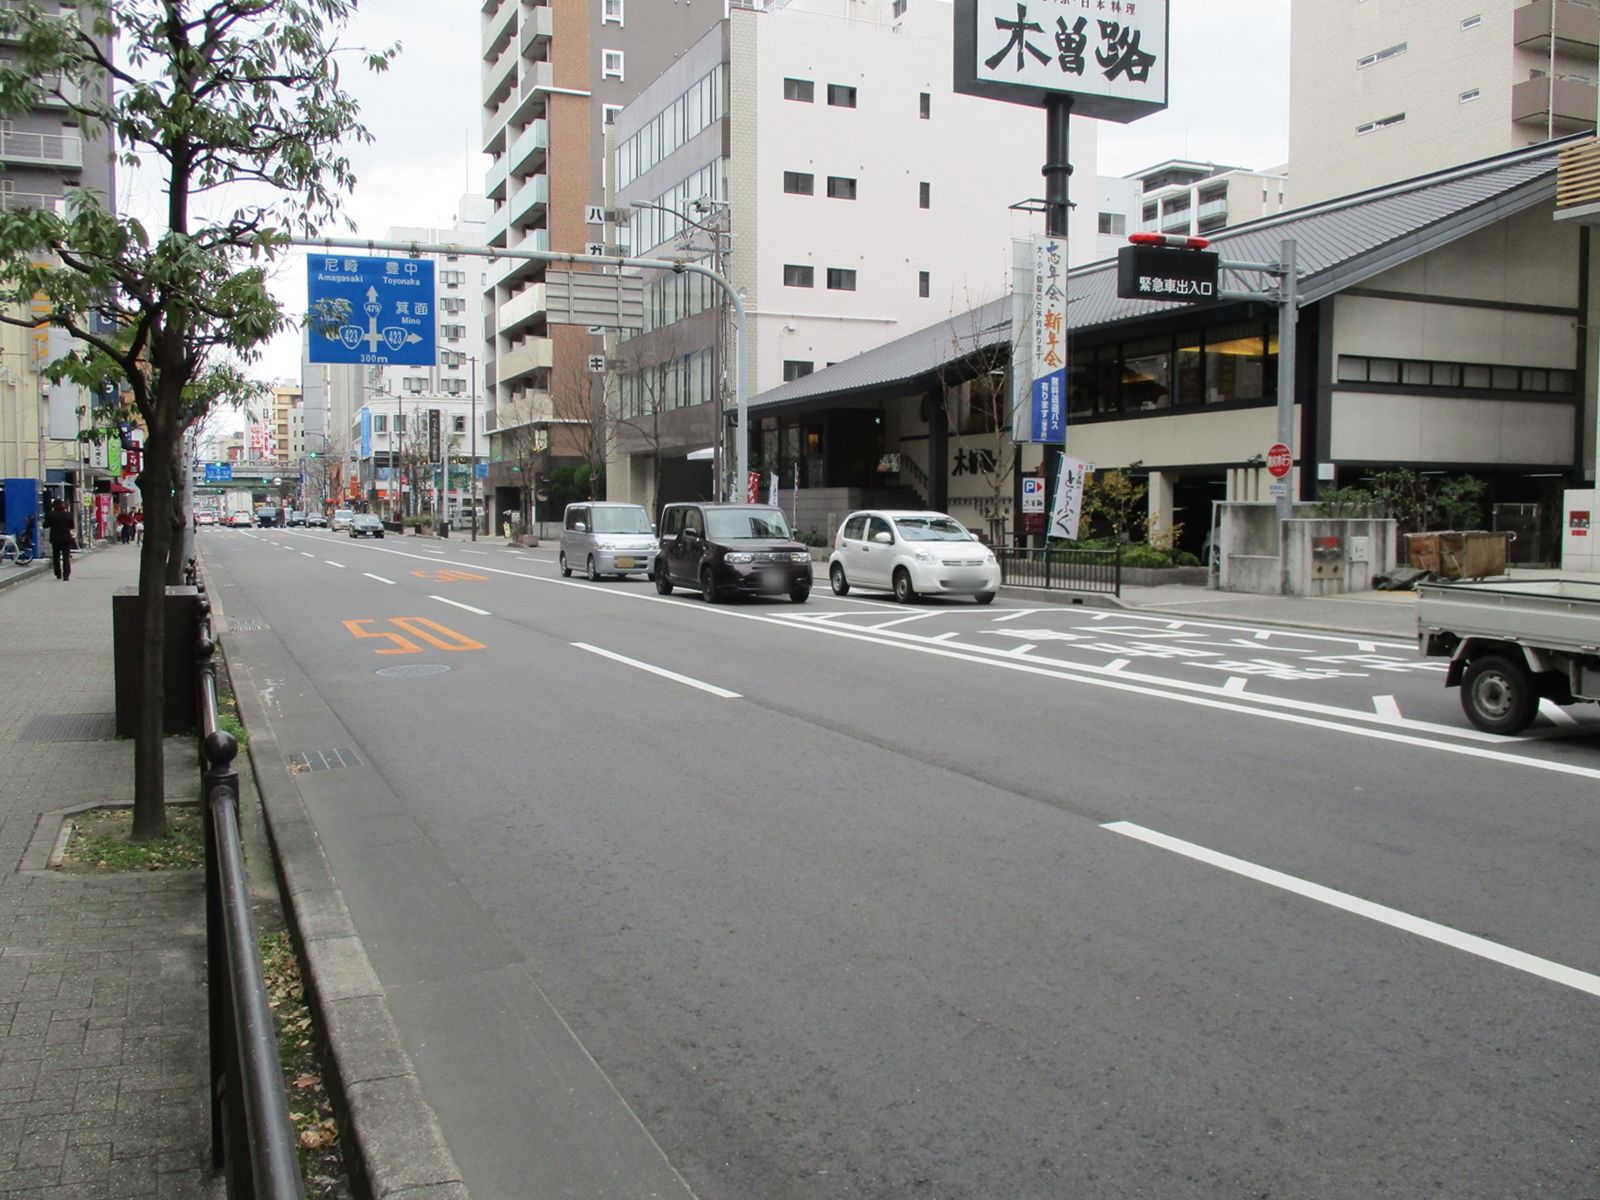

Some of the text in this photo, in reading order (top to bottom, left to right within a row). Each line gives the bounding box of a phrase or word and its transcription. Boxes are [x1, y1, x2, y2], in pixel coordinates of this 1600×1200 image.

[984, 3, 1157, 83] 木曽路
[325, 258, 358, 272] 尼崎
[386, 261, 418, 275] 豊中
[318, 273, 363, 283] Amagasaki
[383, 277, 420, 286] Toyonaka
[1139, 276, 1212, 295] 緊急車出入口
[366, 304, 379, 313] 479
[396, 301, 428, 315] 箕面
[1044, 241, 1064, 368] 忘年会・新年会
[401, 316, 421, 325] Mino
[344, 329, 358, 342] 423
[388, 332, 402, 344] 423
[360, 354, 388, 363] 300m
[341, 616, 489, 655] 50
